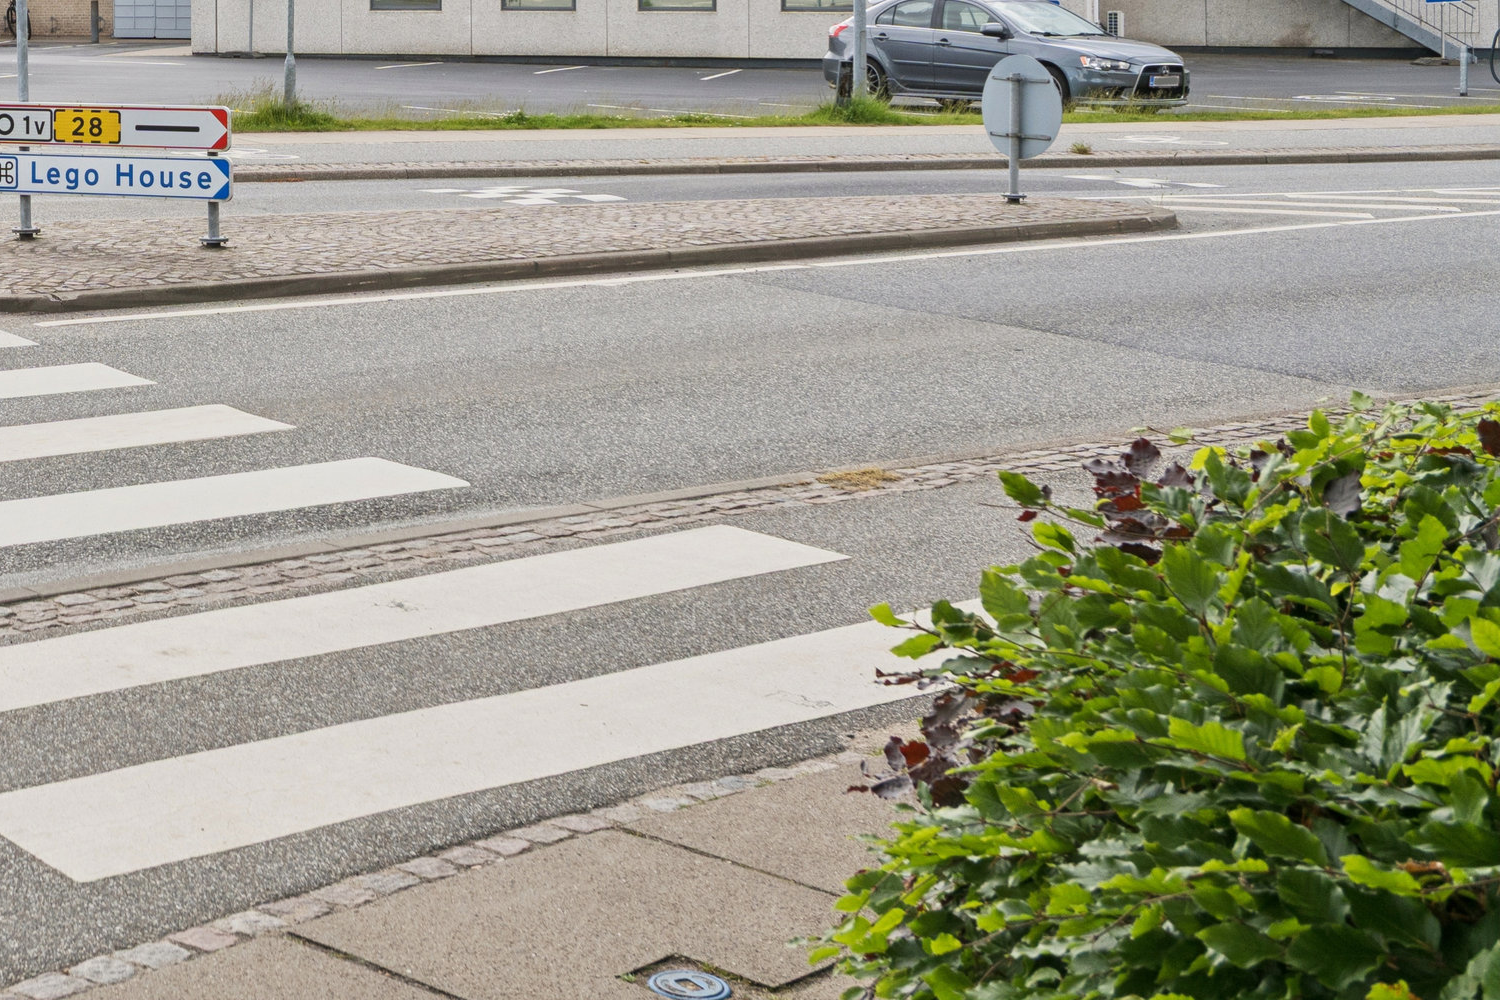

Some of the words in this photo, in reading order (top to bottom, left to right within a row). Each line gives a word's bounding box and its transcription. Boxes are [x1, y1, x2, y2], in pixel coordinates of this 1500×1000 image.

[23, 115, 46, 135] 1v
[72, 116, 103, 137] 28
[31, 160, 99, 190] Lego
[116, 163, 212, 190] House
